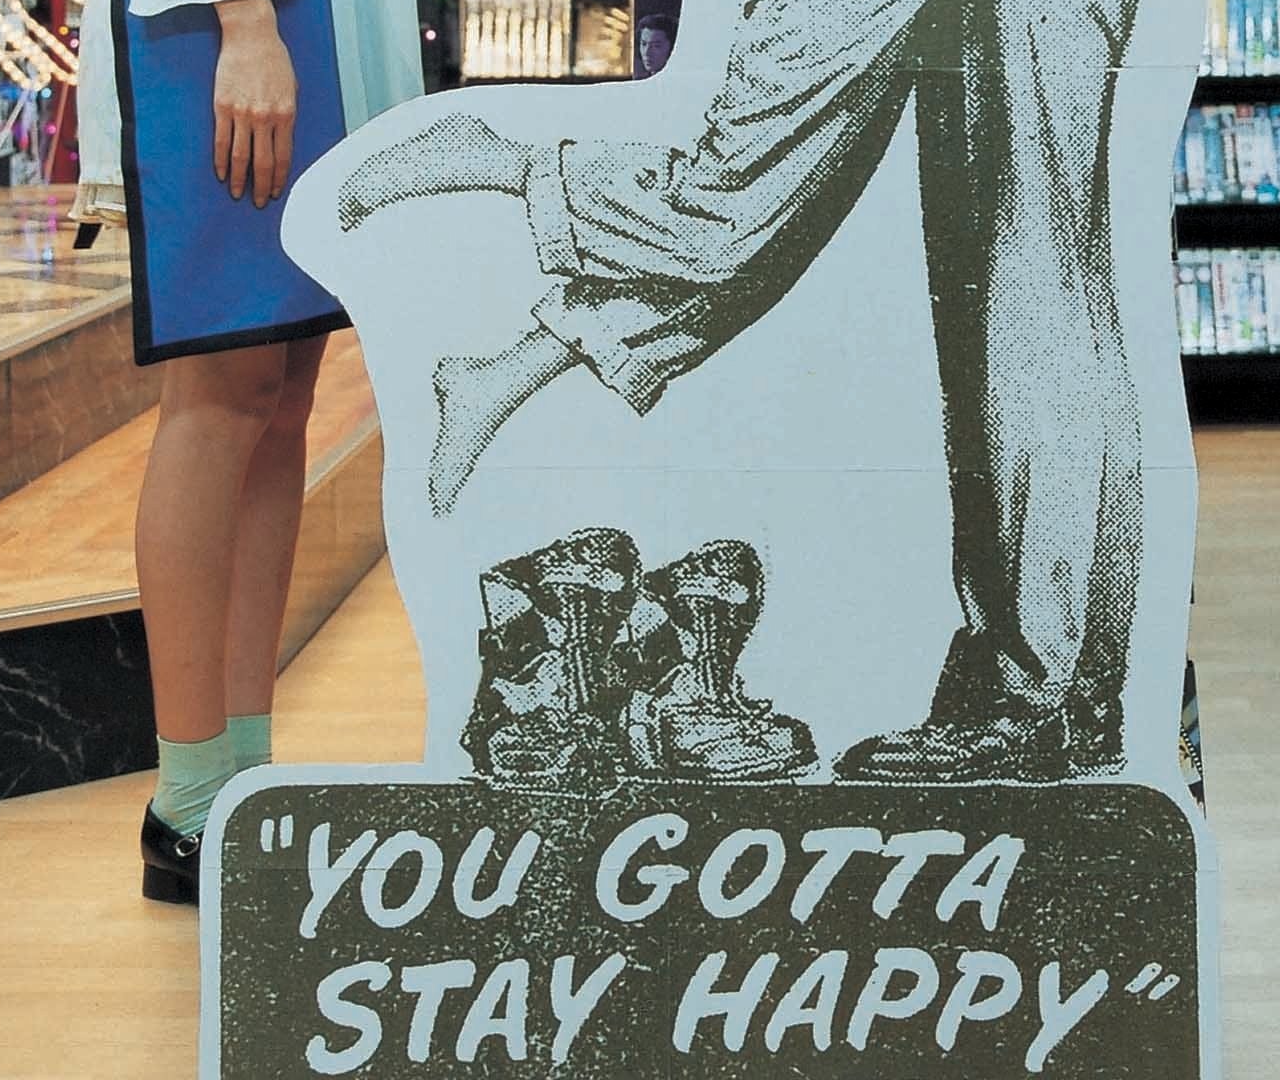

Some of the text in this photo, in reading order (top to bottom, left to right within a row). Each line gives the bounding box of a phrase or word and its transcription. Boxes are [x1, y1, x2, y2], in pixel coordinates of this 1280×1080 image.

[261, 812, 1026, 940] "YOU GOTTA
[304, 950, 628, 1076] STAY
